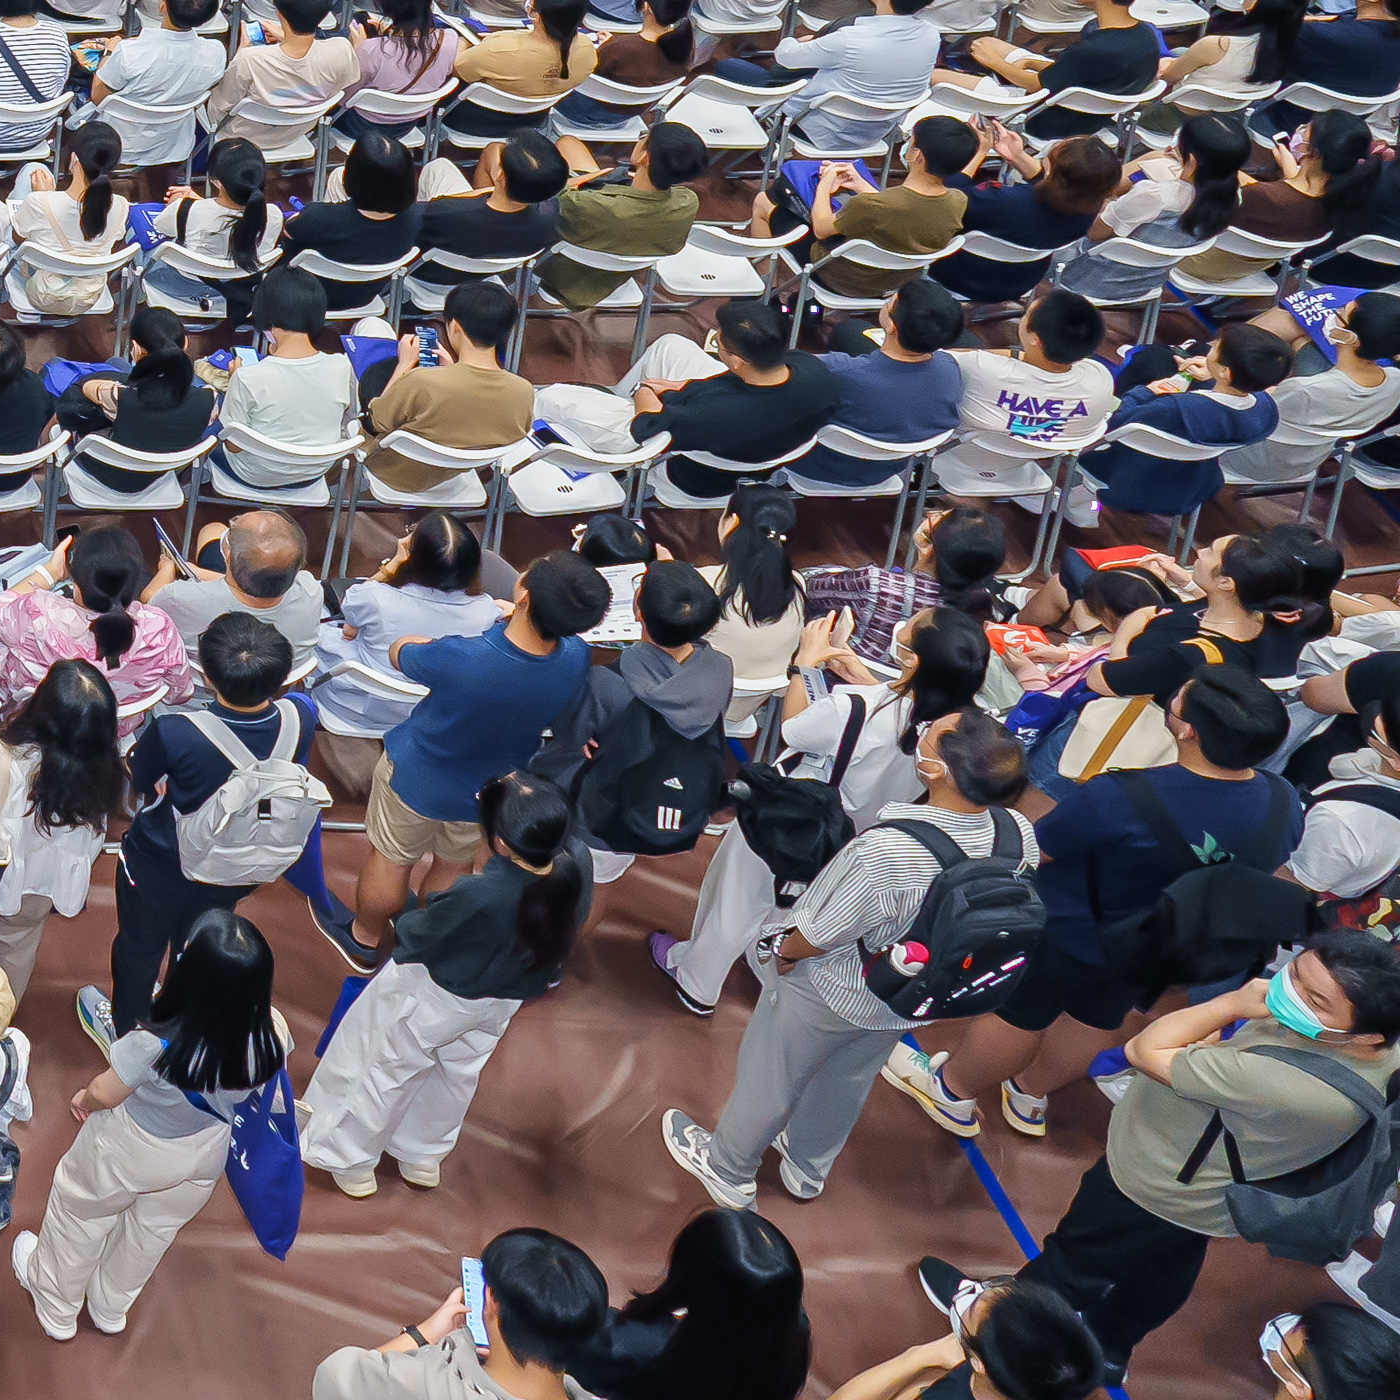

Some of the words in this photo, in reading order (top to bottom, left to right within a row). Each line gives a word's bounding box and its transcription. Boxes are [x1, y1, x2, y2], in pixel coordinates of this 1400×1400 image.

[1285, 291, 1308, 304] WE
[1292, 292, 1336, 313] SHAPE
[1298, 303, 1326, 319] THE
[996, 389, 1064, 418] HAVE
[1068, 400, 1088, 417] A
